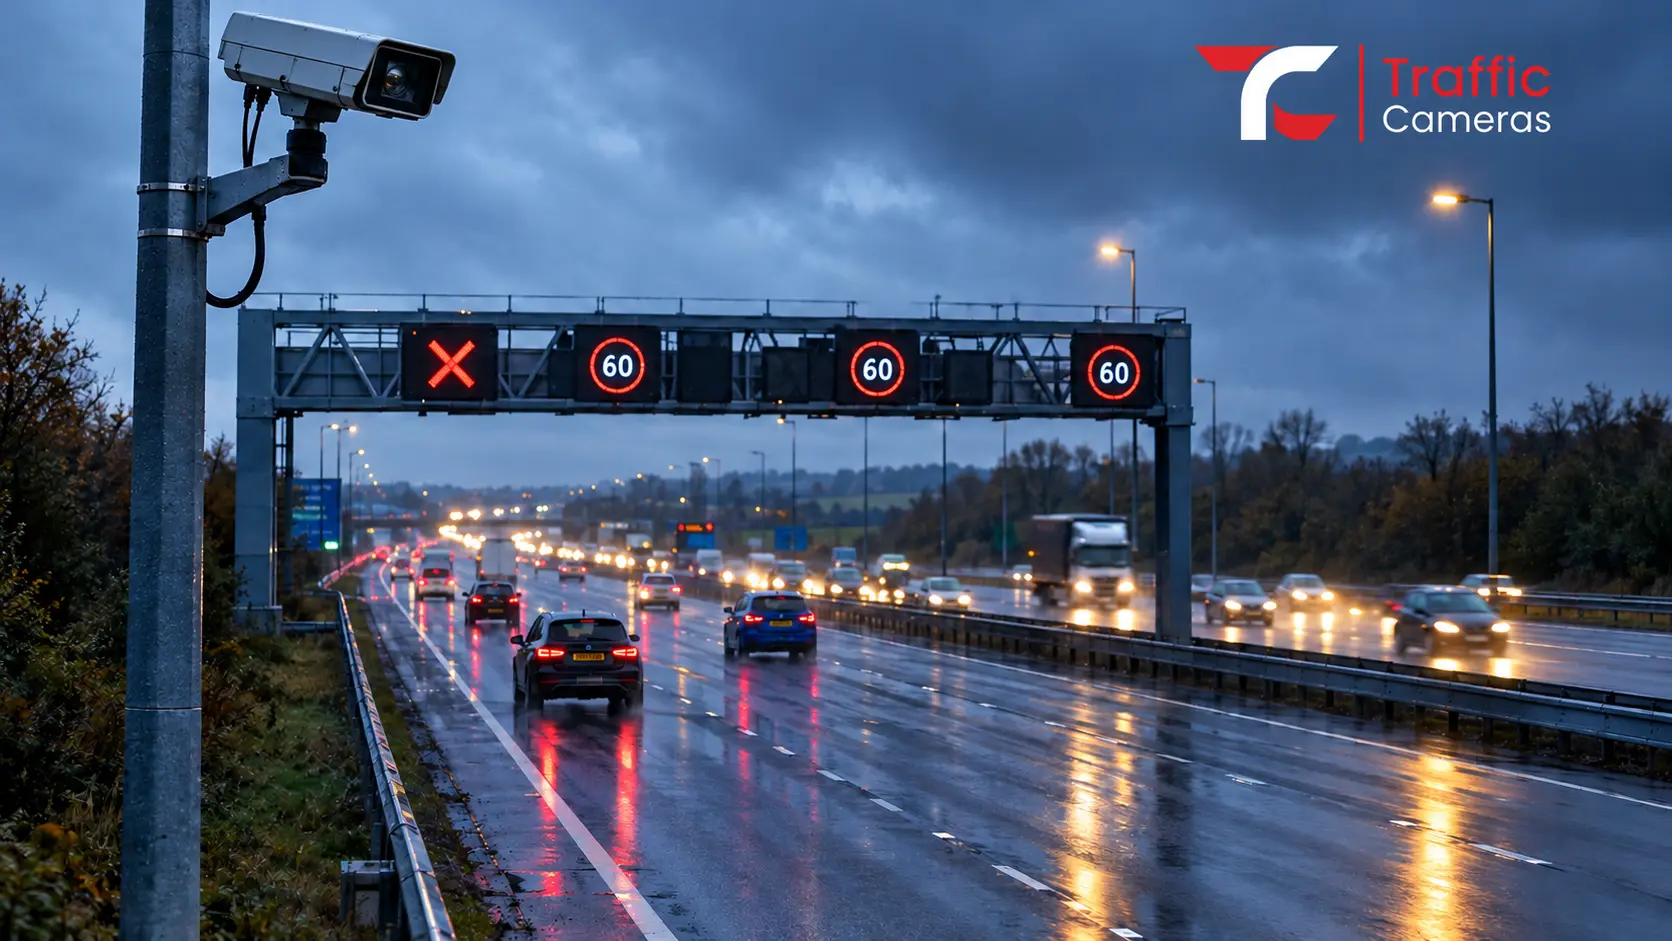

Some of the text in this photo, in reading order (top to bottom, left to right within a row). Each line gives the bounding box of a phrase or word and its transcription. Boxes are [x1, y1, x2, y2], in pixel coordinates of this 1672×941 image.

[602, 354, 633, 377] 60
[863, 358, 893, 381] 60
[1099, 361, 1129, 384] 60
